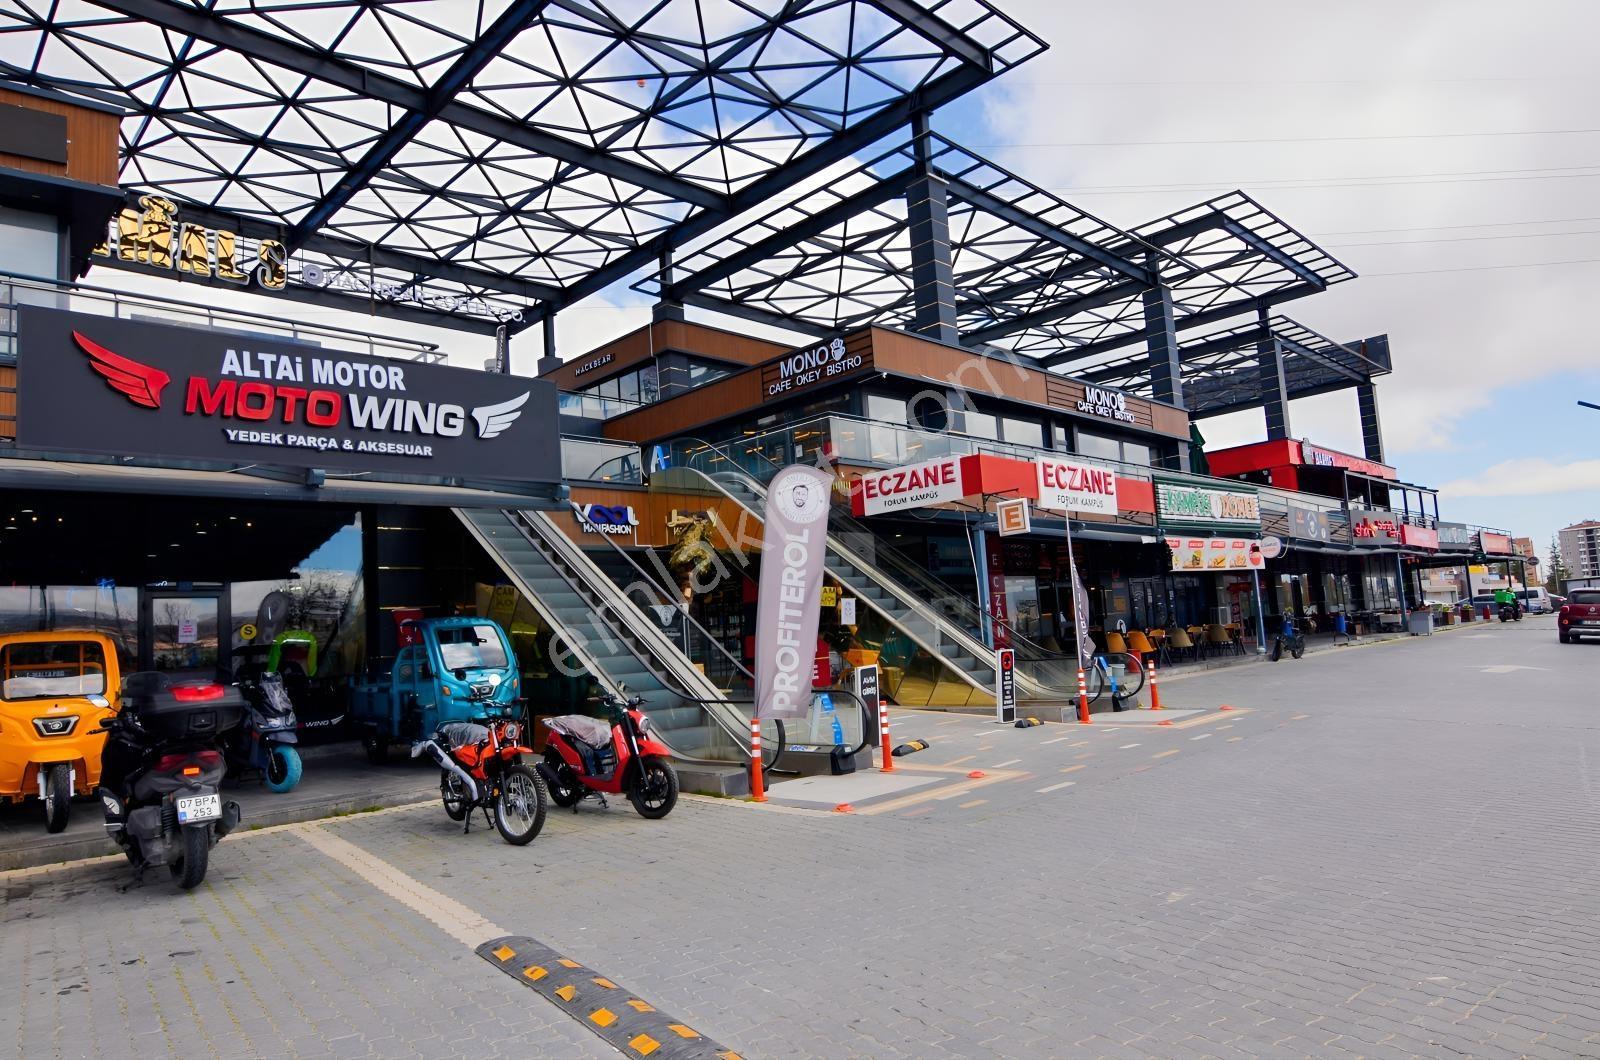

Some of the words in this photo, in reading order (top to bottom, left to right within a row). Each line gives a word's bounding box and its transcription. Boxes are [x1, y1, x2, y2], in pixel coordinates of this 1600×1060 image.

[780, 346, 828, 379] MONO
[312, 358, 407, 391] MOTOR
[769, 379, 791, 395] CAFE
[797, 369, 820, 386] OKEY
[827, 355, 862, 376] BISTRO
[1077, 400, 1095, 413] CAFE
[1085, 386, 1118, 409] MONO
[226, 429, 284, 446] YEDEK
[287, 434, 338, 451] PARÇA
[342, 439, 354, 450] &
[358, 440, 433, 457] AKSESUAR
[865, 462, 956, 499] ECZANE
[1043, 462, 1114, 496] ECZANE
[884, 498, 907, 507] FORUM
[910, 491, 939, 503] KAMPÜS
[1057, 495, 1079, 505] FORUM
[1005, 507, 1022, 529] E
[991, 554, 1005, 649] ECZAN
[862, 676, 876, 685] AVM
[180, 800, 192, 809] 07
[194, 796, 217, 807] BPA
[193, 807, 212, 818] 253
